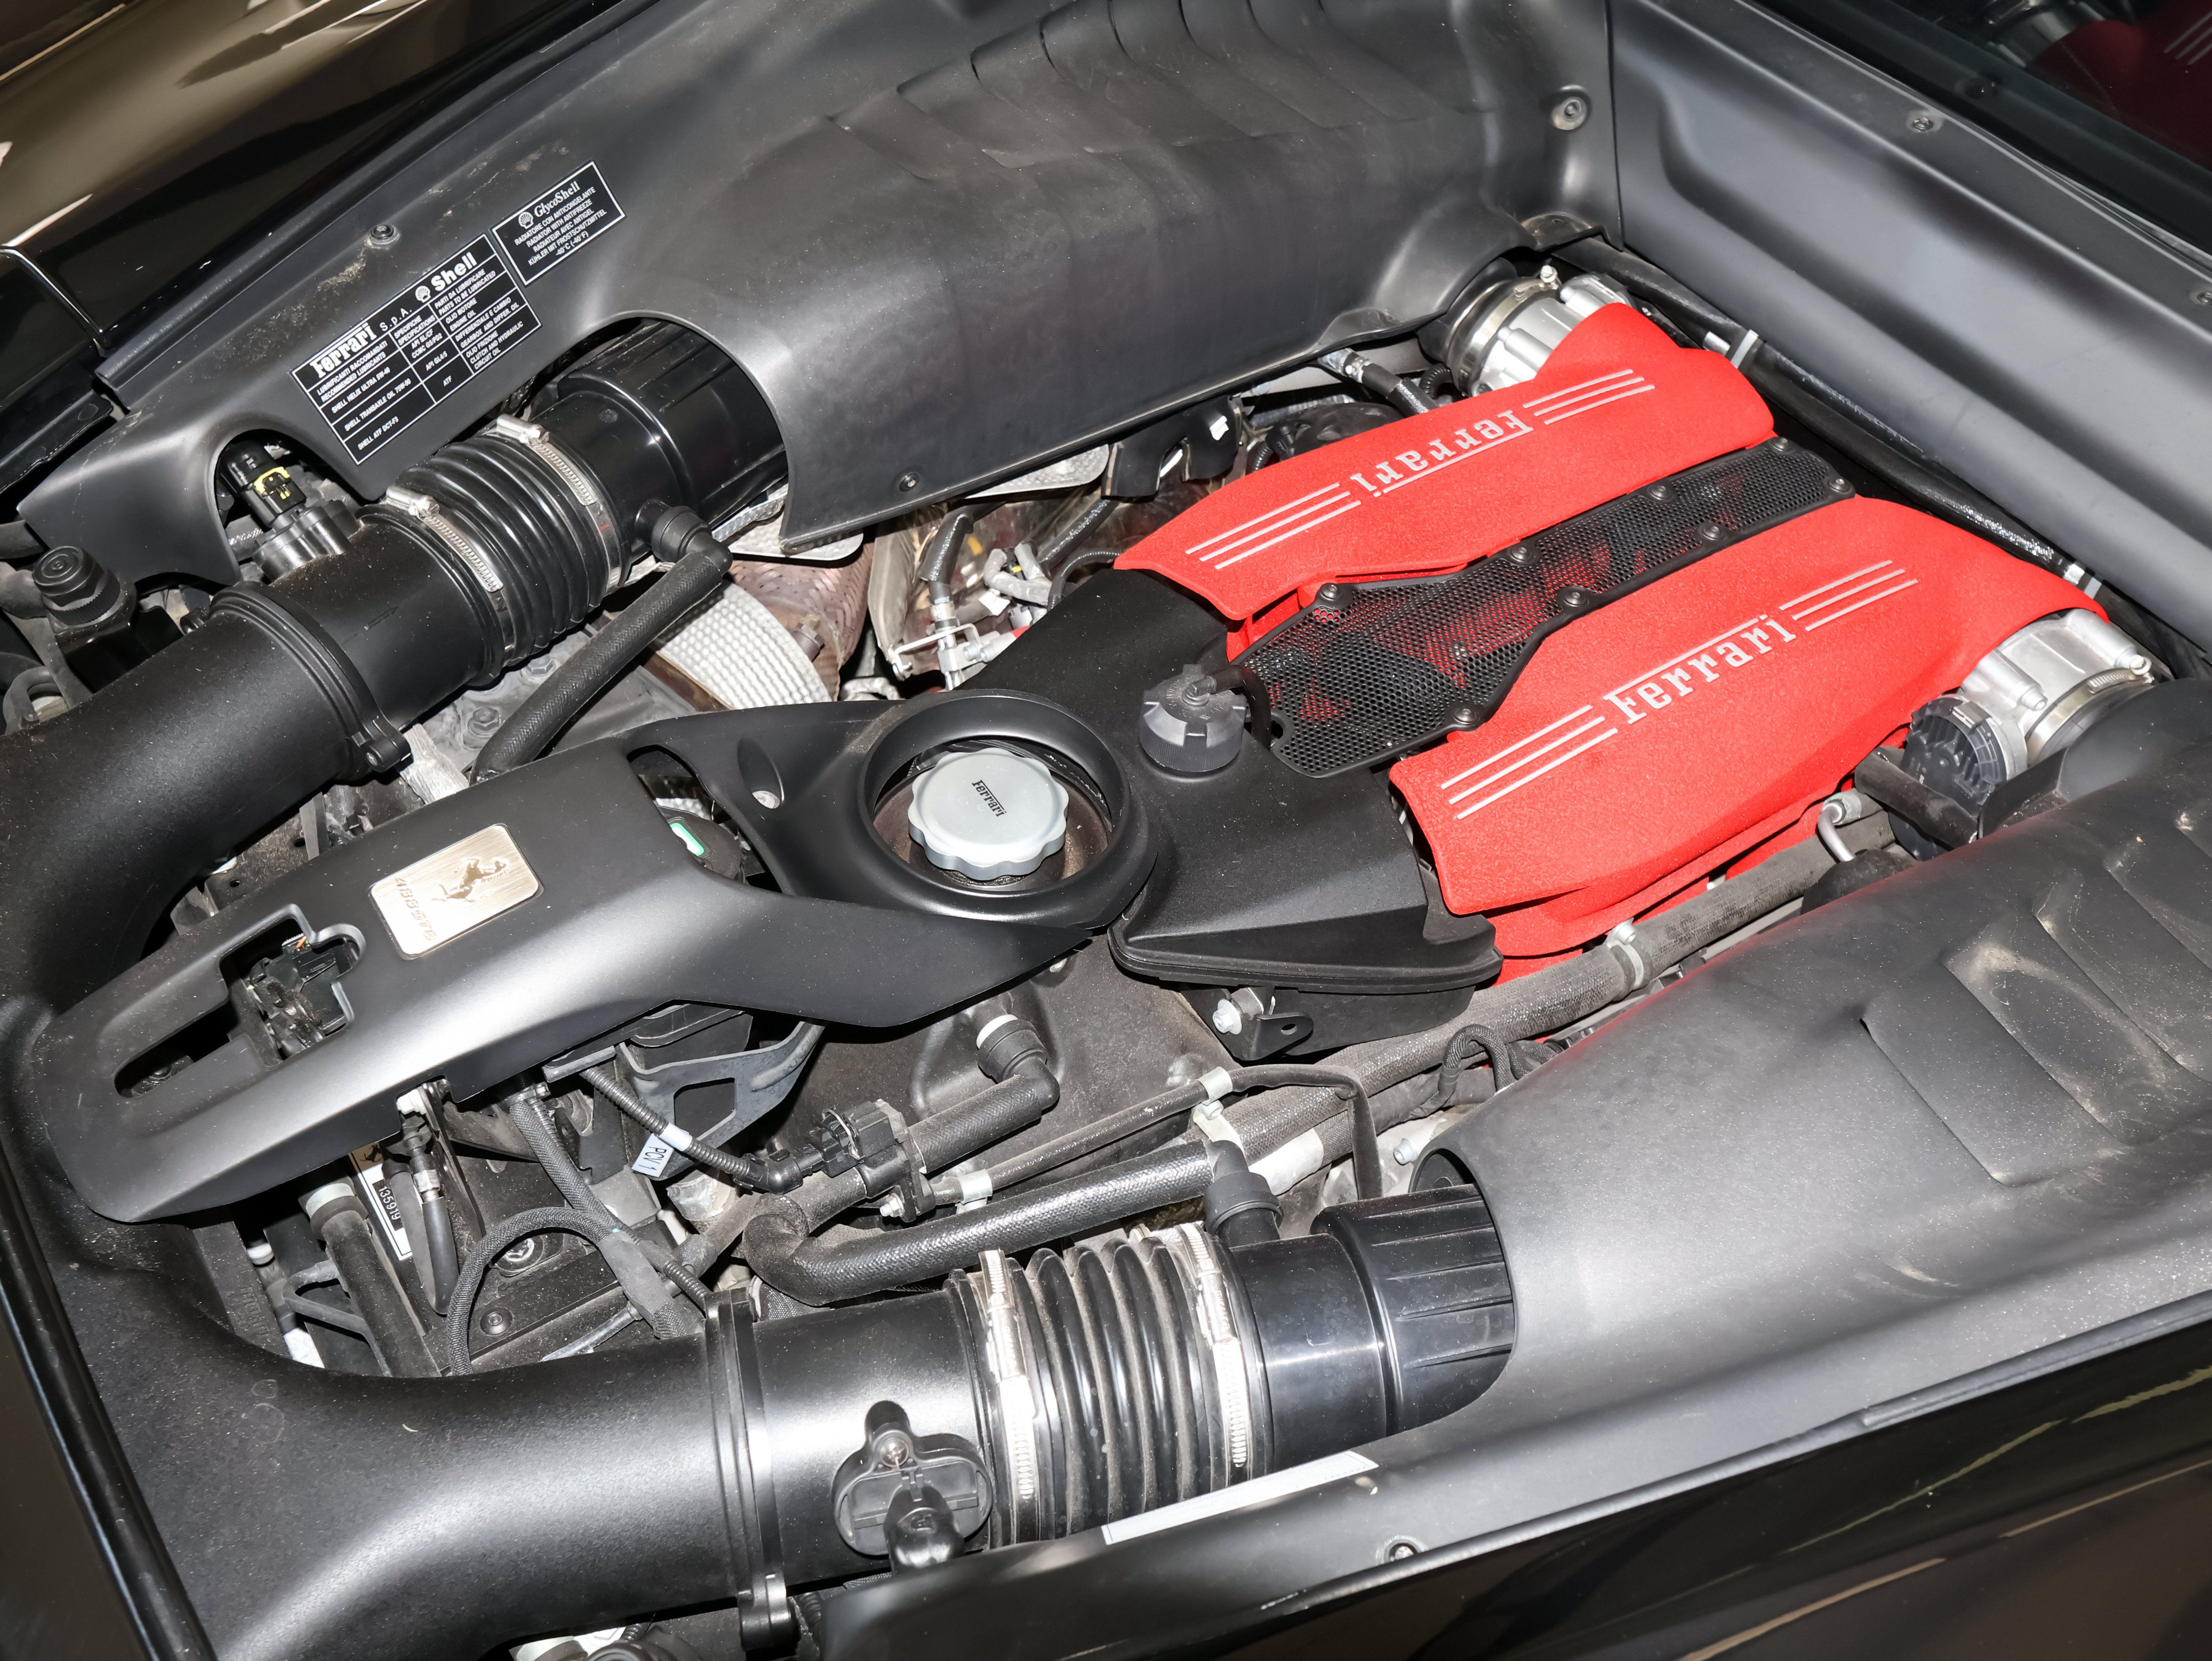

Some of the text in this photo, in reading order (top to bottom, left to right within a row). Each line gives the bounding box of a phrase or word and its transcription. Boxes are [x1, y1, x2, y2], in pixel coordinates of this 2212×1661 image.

[514, 186, 596, 246] RADIATORE CON ANTICONGELANTE
[534, 181, 581, 217] GlycoShell
[526, 198, 593, 247] RADIATOR WITH ANTIFREEZE
[528, 209, 607, 266] KÜHLER MIT FROSTSCHUTZMITTEL
[533, 208, 594, 253] RADIATEUR AVEC ANTIGEL
[434, 268, 486, 309] PARTI DA LUBRIFICARE
[438, 270, 496, 316] PARTS TO BE LUBRICATED
[309, 322, 377, 379] Ferrari
[431, 252, 477, 291] Shell
[394, 315, 422, 339] SPECIFICHE
[398, 315, 436, 346] SPECIFICATIONS
[445, 297, 477, 324] OLIO MOTORE
[449, 310, 476, 332] ENGINE OIL
[455, 313, 490, 342] DIFFERENZIALE
[493, 297, 511, 313] CAMBIO
[460, 328, 483, 348] GEARBOX
[484, 320, 494, 332] AND
[510, 302, 519, 311] OIL
[411, 339, 421, 350] API
[411, 345, 426, 359] CCMC
[466, 330, 499, 358] OLIO FRIZIONE
[470, 321, 524, 364] CLUTCH AND HYDRAULIC
[474, 347, 501, 370] CIRCUIT OIL
[316, 340, 388, 396] LUBRIFICANTI RACCOMANDATI
[321, 351, 386, 402] RECOMMENDED LUBRICANTS
[426, 360, 435, 371] API
[443, 375, 452, 387] ATF
[331, 367, 391, 414] SHELL HELIX ULTRA 5W-40
[344, 416, 361, 431] SHELL
[359, 396, 388, 419] TRANSAXLE
[387, 390, 396, 399] OIL
[357, 416, 399, 450] SHELL ATF DCT-F3
[1350, 410, 1534, 497] Ferrari
[1601, 614, 1797, 725] Ferrari
[972, 779, 1007, 817] Ferrari
[643, 1147, 667, 1164] PCV
[378, 1186, 401, 1220] 135919
